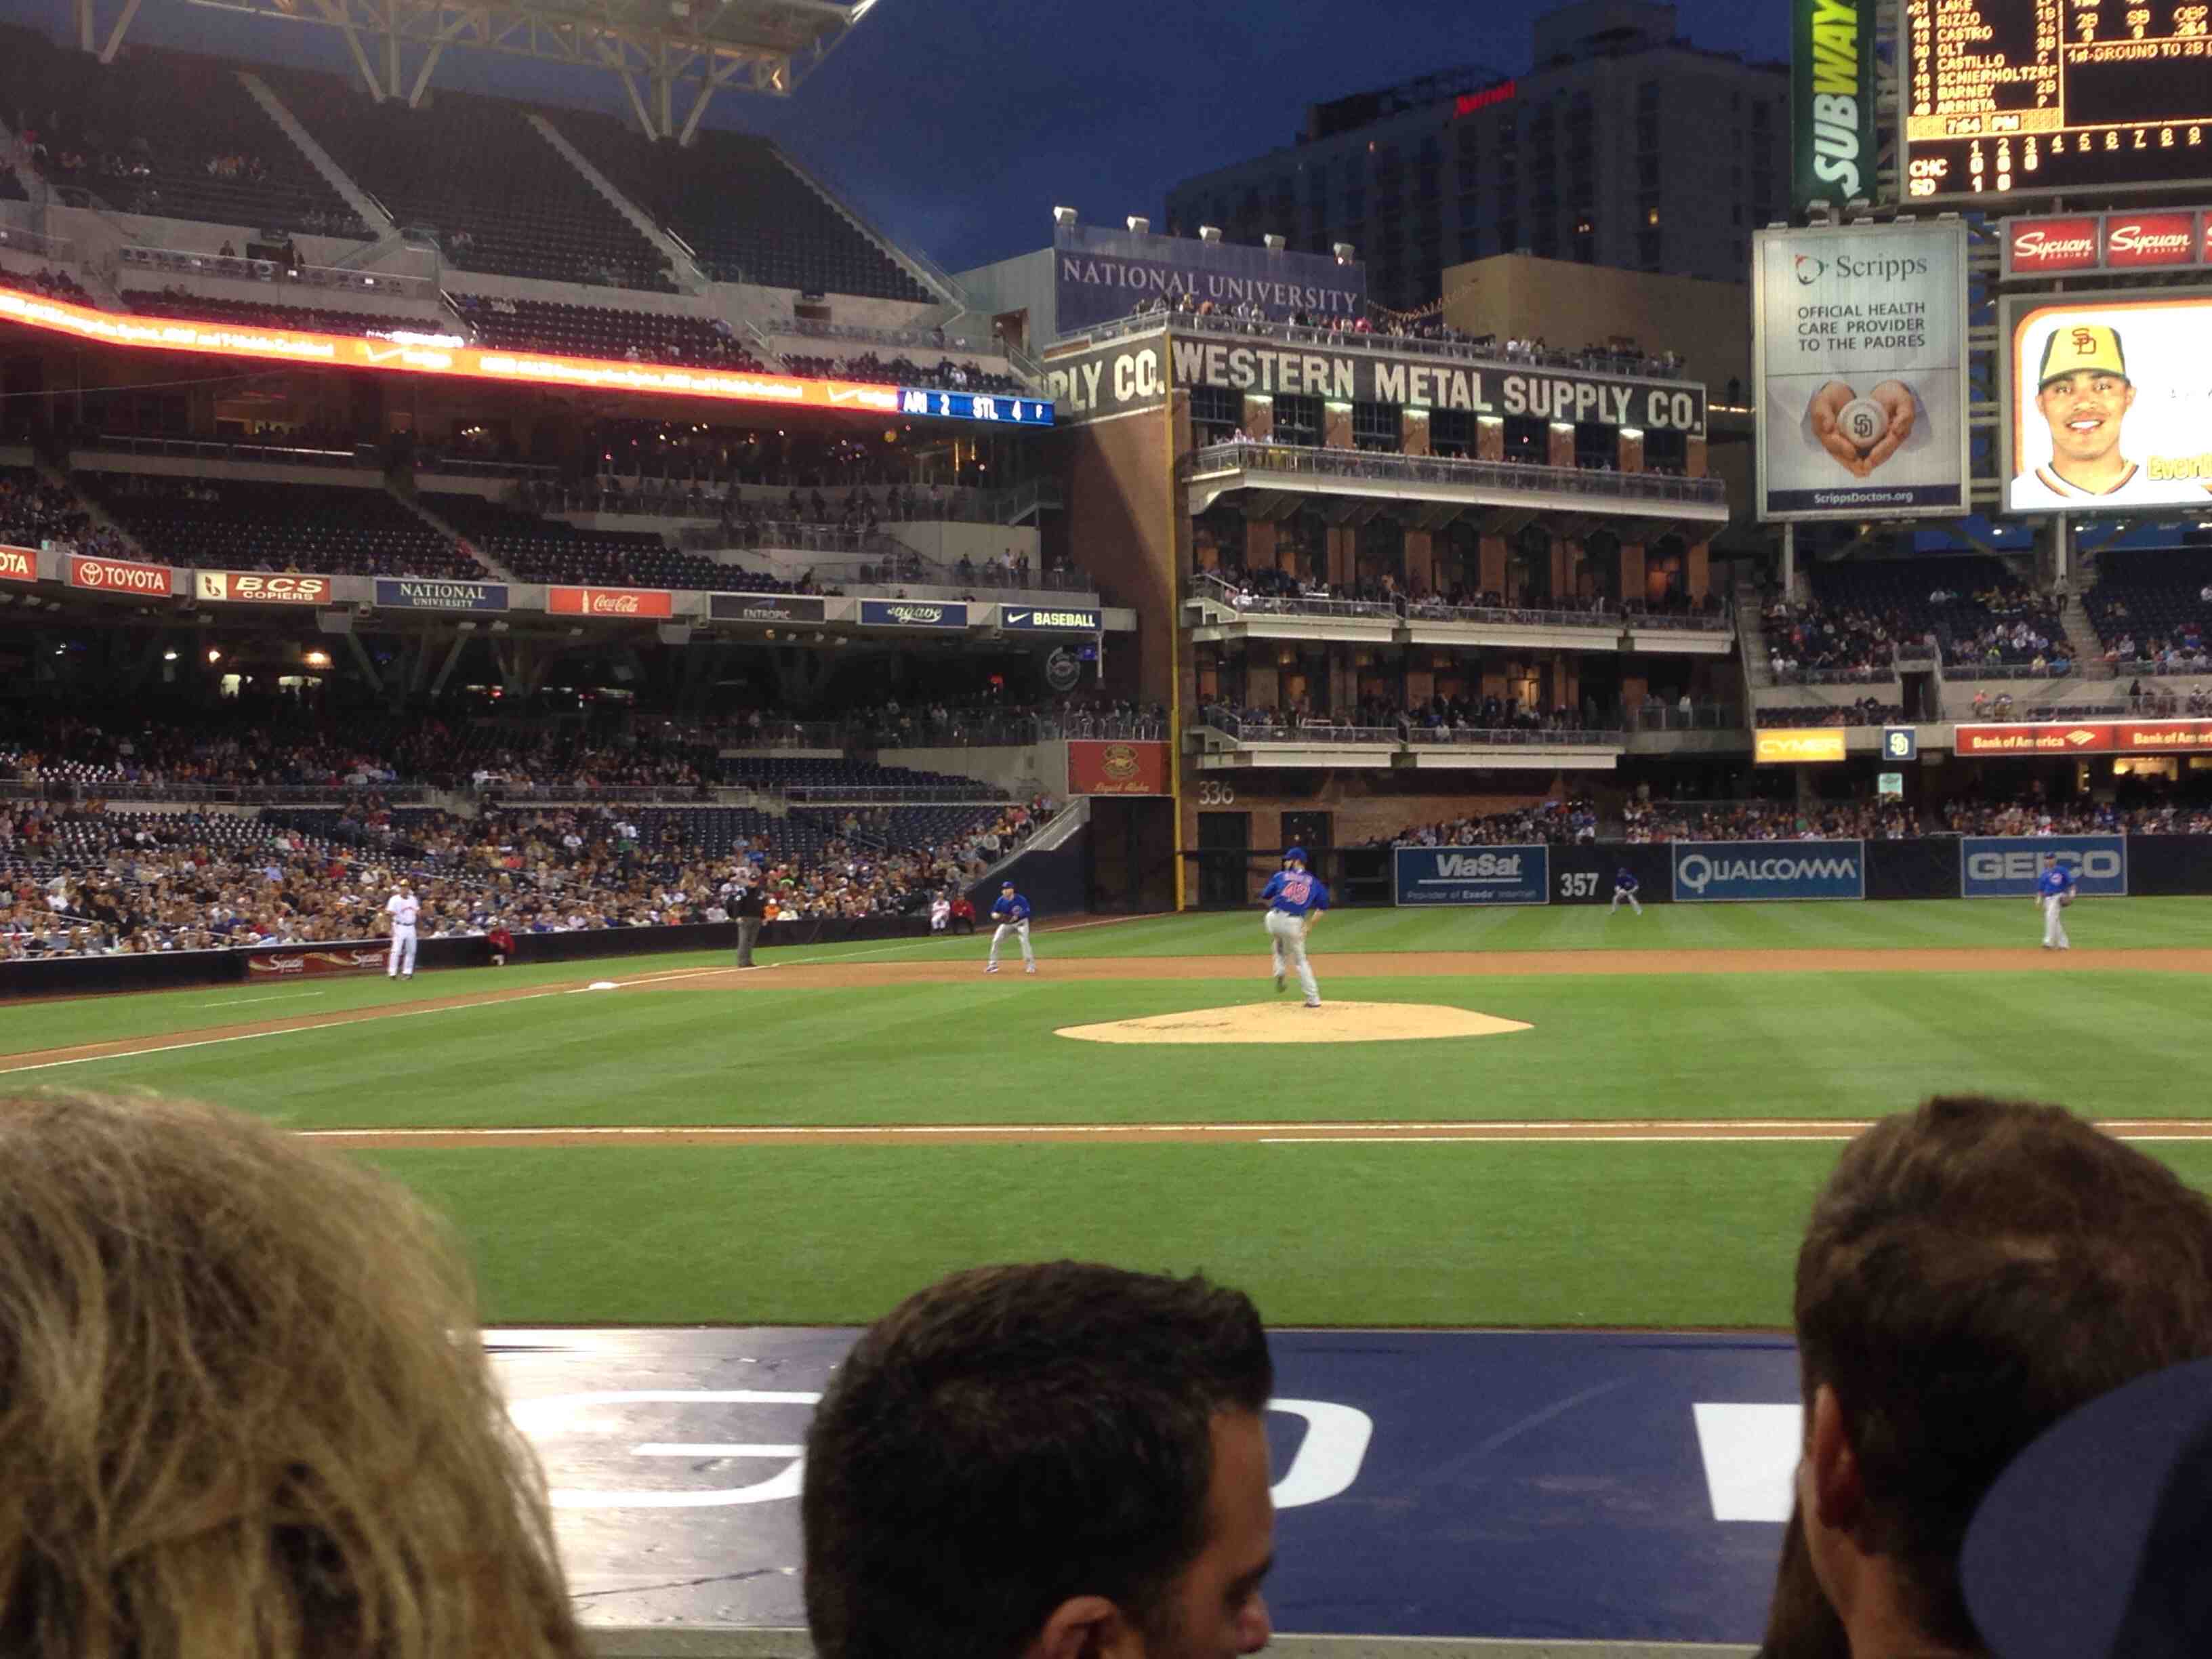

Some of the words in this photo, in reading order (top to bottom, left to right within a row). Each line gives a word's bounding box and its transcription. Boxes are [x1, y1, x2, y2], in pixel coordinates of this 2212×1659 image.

[1936, 0, 1973, 14] LAKE
[1936, 12, 1981, 27] RIZZO
[2036, 7, 2055, 21] 1B
[1937, 26, 1993, 42] CASTRO
[1937, 42, 1965, 56] OLT
[2161, 43, 2181, 56] TO
[2185, 41, 2204, 55] 2B
[1937, 54, 2005, 71] CASTILLO
[2037, 51, 2049, 64] C
[1813, 0, 1862, 198] SUBWAY
[1937, 84, 1994, 100] BARNEY
[2036, 80, 2056, 95] 2B
[2038, 95, 2048, 108] P
[1971, 140, 1982, 157] 1
[1998, 138, 2009, 155] 2
[2024, 136, 2037, 154] 3
[2051, 135, 2064, 152] 4
[2079, 134, 2091, 151] 5
[2106, 131, 2118, 150] 6
[2135, 130, 2146, 148] 7
[1909, 159, 1948, 178] CHC
[1970, 157, 1984, 173] 0
[2024, 154, 2038, 170] 0
[1910, 178, 1936, 196] SD
[1972, 176, 1982, 192] 1
[1997, 173, 2011, 191] 0
[2015, 231, 2093, 260] Sycuan
[2109, 225, 2191, 255] Sycuan
[1836, 252, 1928, 283] Scripps
[1063, 258, 1200, 297] NATIONAL
[1208, 274, 1358, 312] UNIVERSITY
[1798, 304, 1863, 319] OFFICIAL
[1868, 302, 1925, 316] HEALTH
[1798, 321, 1838, 336] CARE
[1847, 318, 1925, 333] PROVIDER
[1799, 339, 1820, 352] TO
[1827, 337, 1857, 350] THE
[1864, 334, 1926, 349] PADRES
[1114, 348, 1166, 402] CO.
[1171, 340, 1355, 399] WESTERN
[1374, 361, 1493, 411] METAL
[1502, 375, 1634, 425] SUPPLY
[1647, 389, 1702, 430] CO.
[903, 390, 928, 414] ARI
[940, 394, 950, 415] 2
[972, 396, 999, 419] STL
[1814, 491, 1914, 504] ScrippsDoctors.org
[104, 567, 166, 591] TOYOTA
[234, 576, 324, 594] BCS
[243, 590, 315, 602] COPIERS
[399, 582, 487, 600] NATIONAL
[412, 597, 474, 609] UNIVERSITY
[744, 608, 792, 620] ENTROPIC
[1032, 611, 1096, 628] BASEBALL
[1759, 737, 1843, 754] CYMER
[1973, 736, 2002, 749] Bank
[2003, 735, 2016, 747] of
[2016, 735, 2065, 747] America
[2133, 733, 2161, 744] Bank
[2163, 732, 2177, 743] of
[1199, 781, 1234, 805] 336
[1435, 853, 1522, 878] ViaSat
[1679, 854, 1858, 894] QUALCOMM
[1560, 872, 1599, 897] 357
